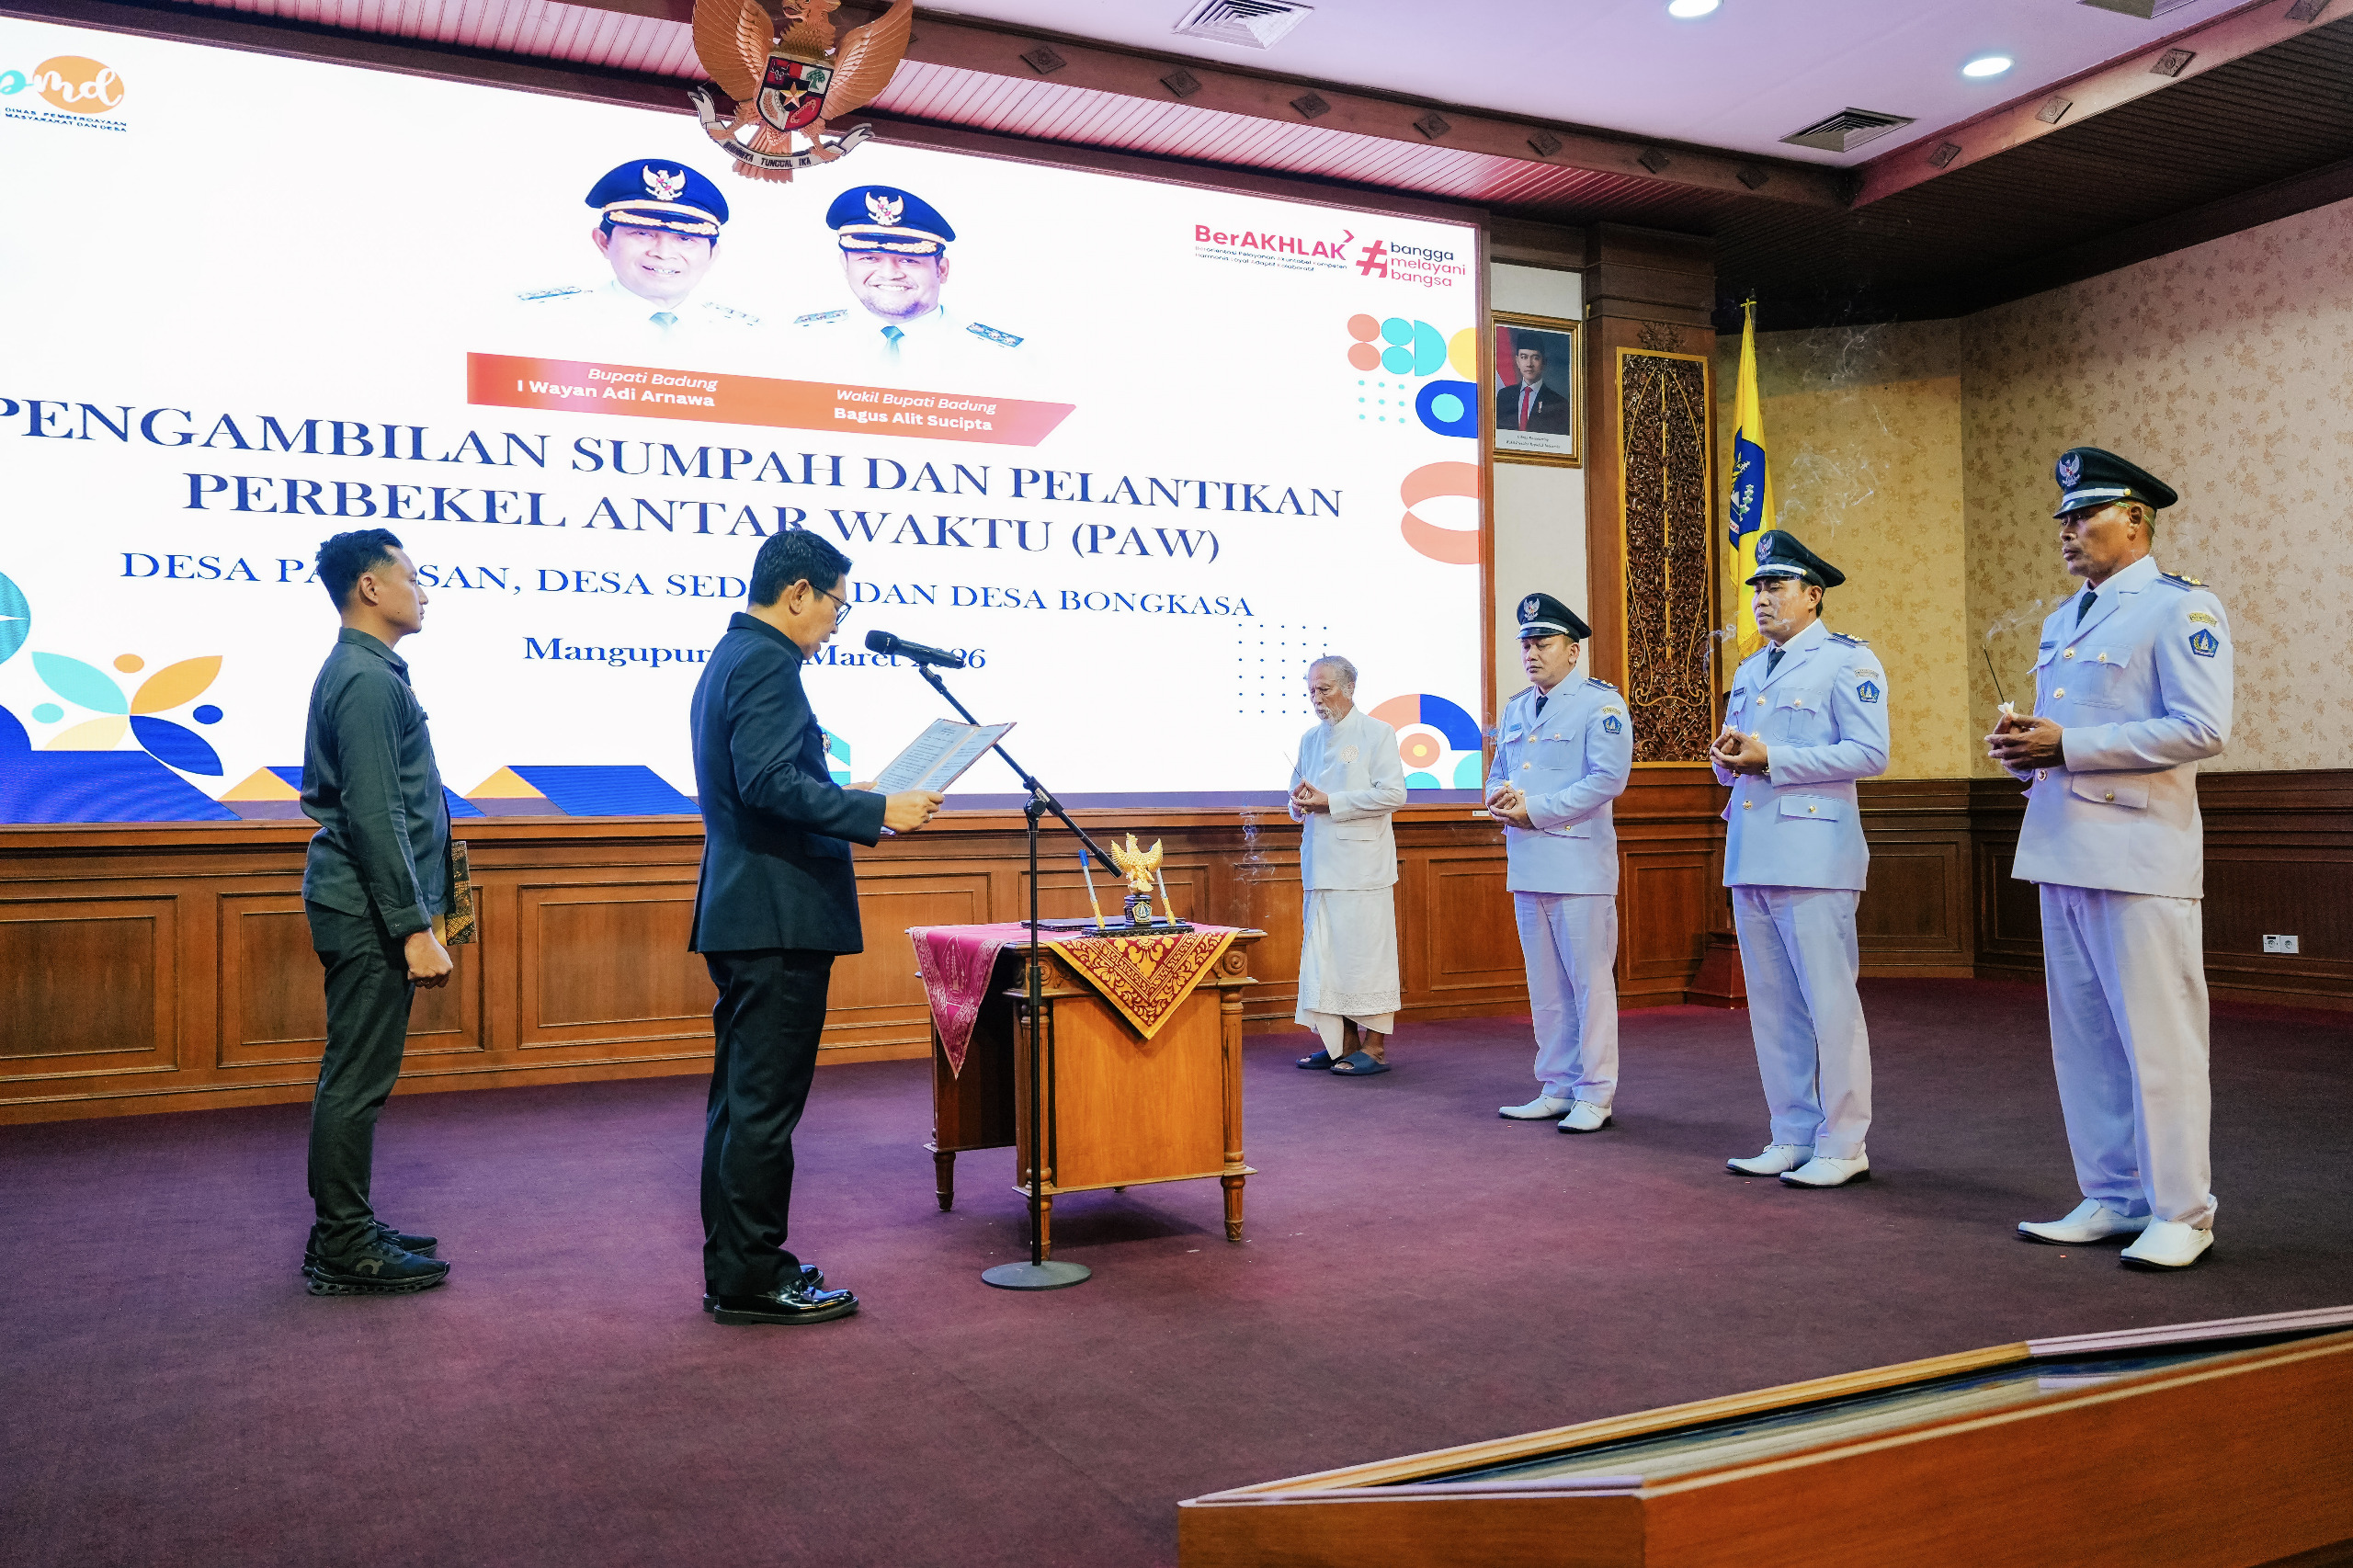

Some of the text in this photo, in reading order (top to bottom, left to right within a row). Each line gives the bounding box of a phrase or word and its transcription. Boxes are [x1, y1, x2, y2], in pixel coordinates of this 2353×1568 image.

[6, 108, 127, 127] DINAS PEMBERDAYAAN
[6, 113, 74, 126] MASYARAKAT
[761, 157, 793, 168] TUNGGAL
[798, 156, 812, 166] IKA
[1195, 224, 1347, 261] BerAKHLAK
[1391, 241, 1455, 263] bangga
[1391, 256, 1467, 276] melayani
[1391, 268, 1453, 288] bangsa
[588, 369, 719, 392] Bupati Badung
[517, 380, 715, 407] I Wayan Adi Arnawa
[836, 389, 997, 415] Wakil Bupati Badung
[834, 407, 994, 432] Bagus Alit Sucipta
[572, 437, 846, 486] SUMPAH
[862, 457, 992, 496] DAN
[1008, 467, 1344, 517] PELANTIKAN
[182, 472, 1220, 563] PERBEKEL ANTAR WAKTU (PAW)
[120, 552, 1256, 617] DESA PSAN, DESA SED DAN DESA BONGKASA
[522, 637, 711, 668] Mangupur
[802, 645, 902, 666] Maret
